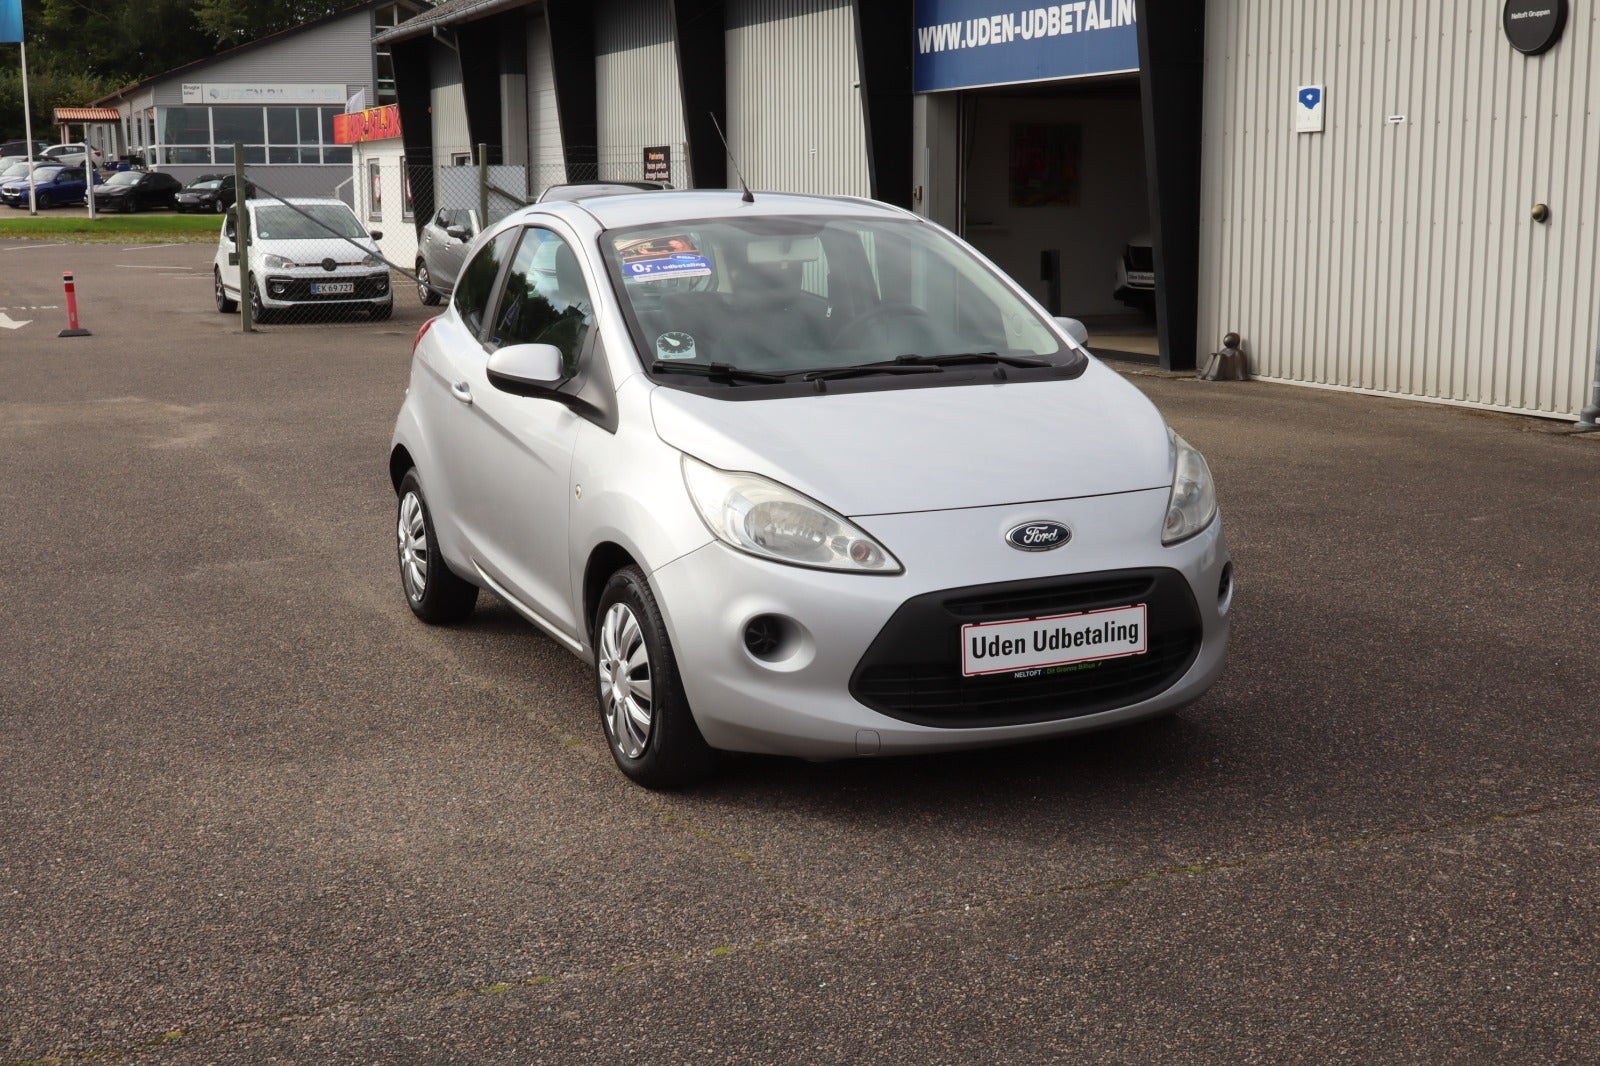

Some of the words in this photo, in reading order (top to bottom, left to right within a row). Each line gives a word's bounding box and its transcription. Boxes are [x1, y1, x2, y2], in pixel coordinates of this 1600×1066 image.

[1511, 11, 1528, 19] Neltoft
[1529, 9, 1551, 18] Gruppen
[918, 0, 1137, 54] WWW.UDEN-UDBETALIN
[662, 262, 707, 270] udbetaling
[1023, 526, 1058, 544] Ford
[972, 635, 1026, 659] Uden
[1033, 621, 1139, 652] Udbetaling
[1014, 669, 1042, 678] NELTOFT
